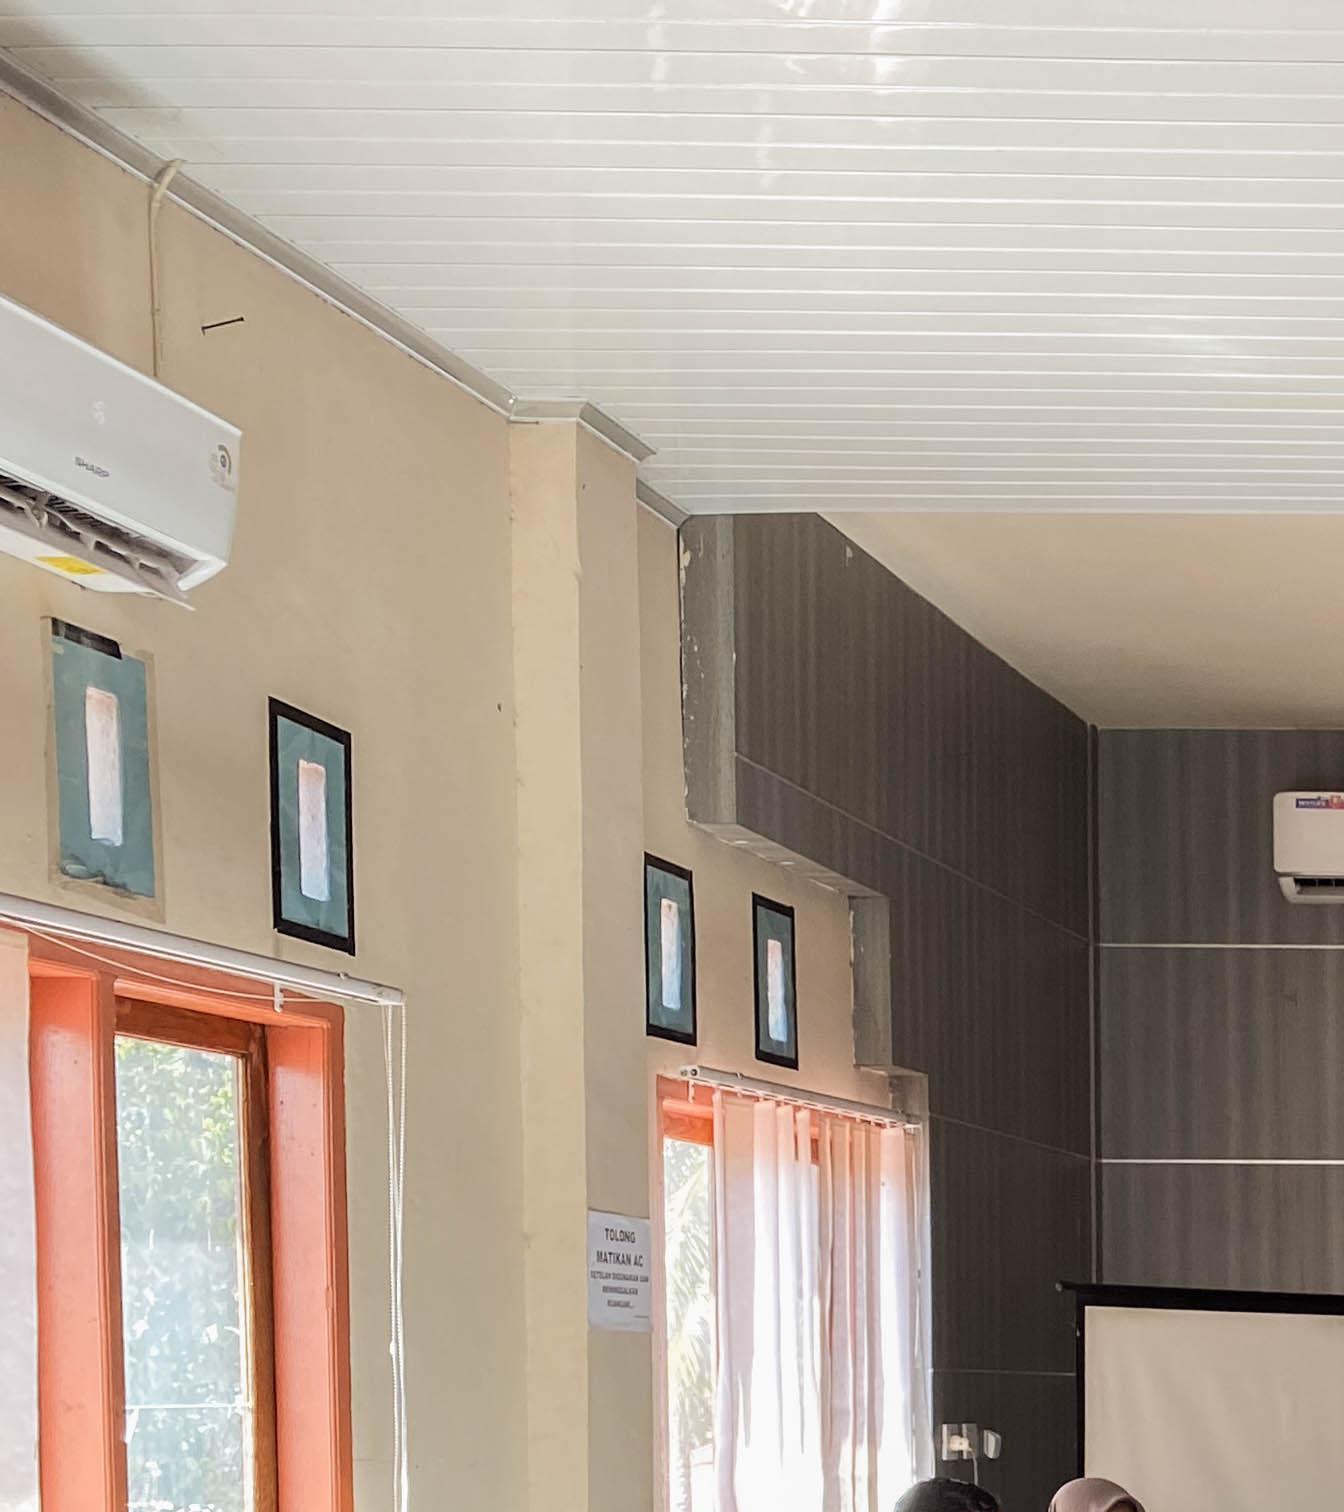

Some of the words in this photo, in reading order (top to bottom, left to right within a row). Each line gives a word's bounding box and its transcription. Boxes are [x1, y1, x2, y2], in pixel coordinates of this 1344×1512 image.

[604, 1227, 636, 1243] TOLONG
[596, 1250, 632, 1265] MATIKAN
[633, 1255, 644, 1267] AC
